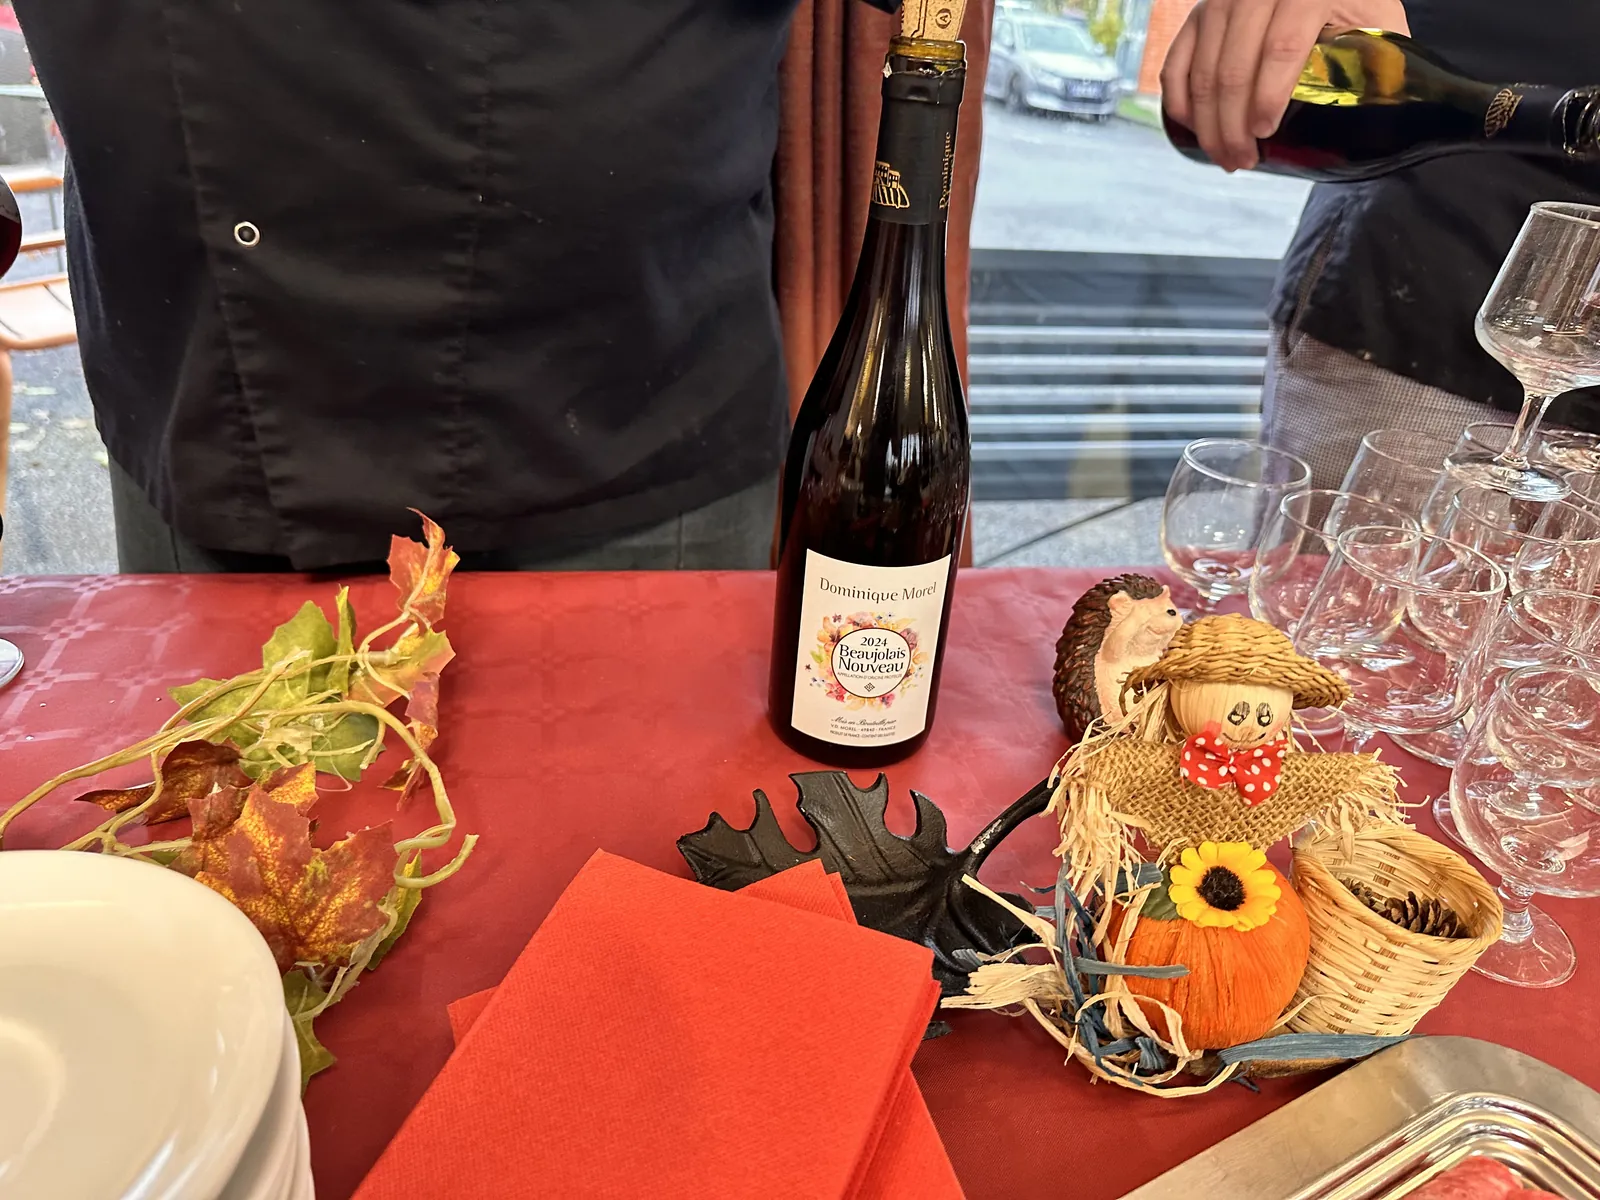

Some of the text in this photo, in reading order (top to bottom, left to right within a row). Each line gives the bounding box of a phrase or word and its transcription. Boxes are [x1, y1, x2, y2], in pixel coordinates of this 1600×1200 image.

[939, 131, 951, 209] Dominique
[820, 577, 937, 604] Dominique Morel
[860, 636, 888, 647] 2024
[839, 643, 906, 663] Beaujolais
[838, 656, 904, 674] Nouveau
